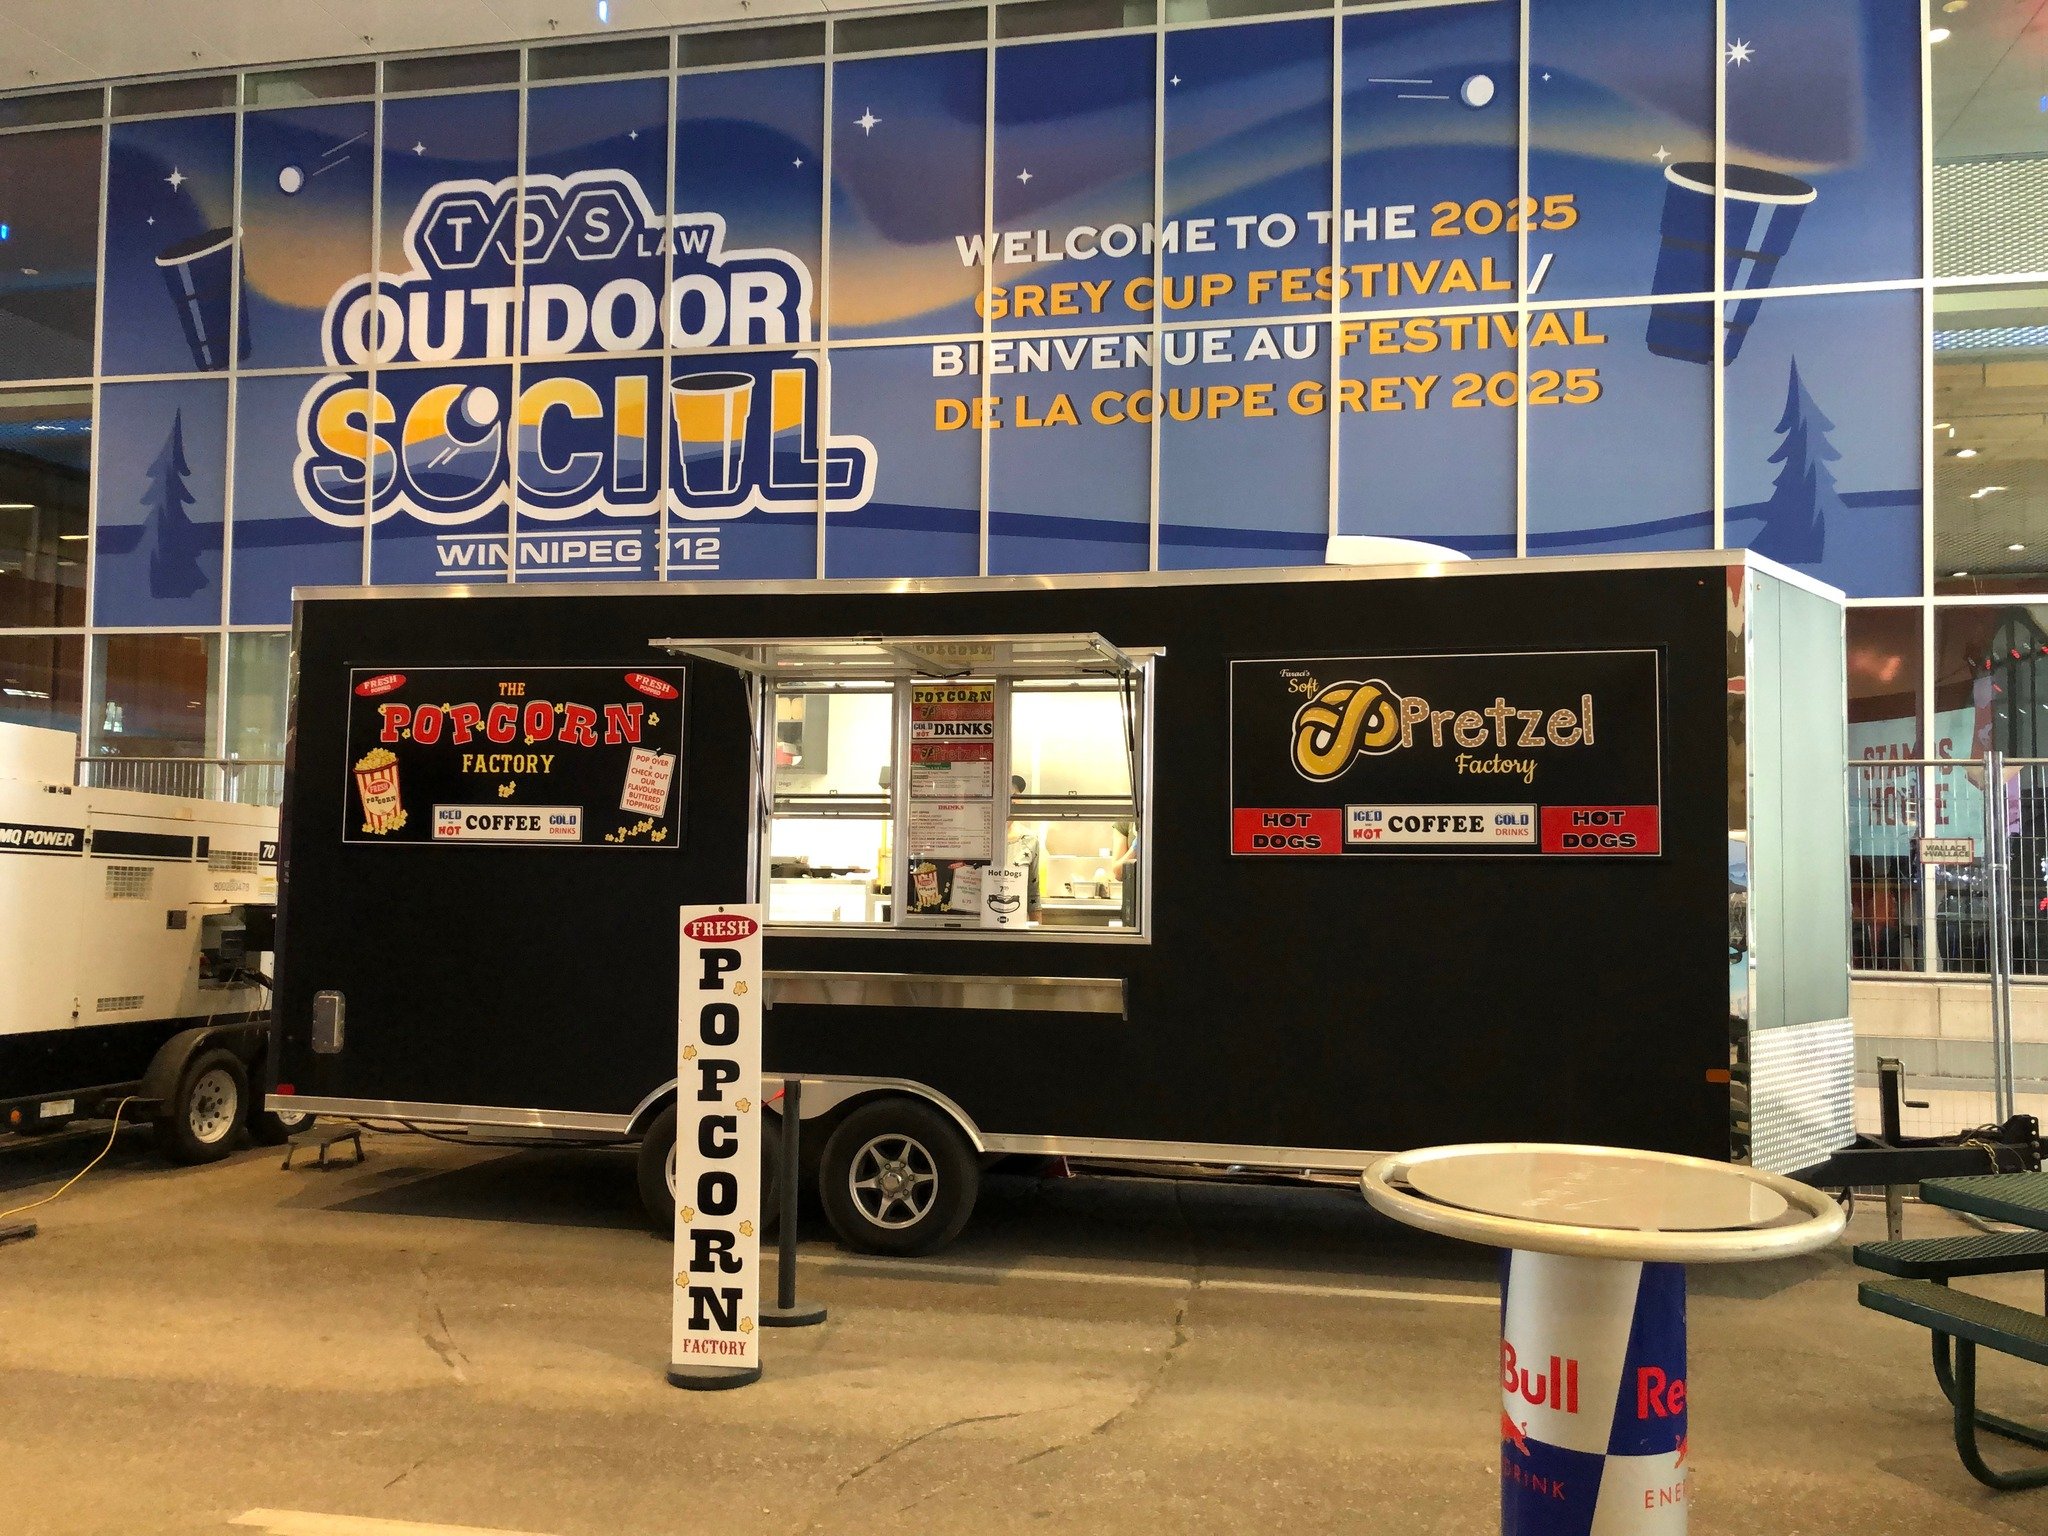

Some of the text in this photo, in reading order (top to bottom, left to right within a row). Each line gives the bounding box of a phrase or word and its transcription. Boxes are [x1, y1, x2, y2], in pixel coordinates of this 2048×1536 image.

[955, 193, 1578, 267] WELCOME TO THE 2025
[637, 229, 709, 258] LAW
[974, 280, 1112, 321] GREY
[1123, 272, 1233, 312] CUP
[1248, 256, 1512, 305] FESTIVAL
[341, 270, 790, 365] OUTDOOR
[932, 310, 1606, 377] BIENVENUE AU FESTIVAL
[935, 367, 1601, 431] DE LA COUPE GREY 2025
[436, 539, 642, 567] WINNIPEG
[363, 674, 397, 690] FRESH
[498, 682, 526, 696] THE
[634, 673, 671, 693] FRESH
[1287, 676, 1320, 700] Soft
[914, 690, 992, 703] POPCORN
[379, 700, 644, 748] POPCORN
[934, 723, 992, 736] DRINKS
[1400, 693, 1595, 749] Pretzel
[461, 754, 556, 774] FACTORY
[636, 754, 669, 767] POP OVER
[1454, 752, 1538, 784] Factory
[1863, 737, 1953, 781] STAMS
[631, 767, 669, 780] CHECK OUT
[640, 777, 656, 786] OUR
[627, 783, 666, 796] FLAVOURED
[628, 791, 661, 804] BUTTERED
[438, 809, 462, 820] ICED
[1867, 783, 1950, 826] HOUE
[465, 814, 577, 832] COFFEE COLD
[1262, 809, 1627, 833] HOT COFFEE COLD HOT
[1353, 809, 1383, 822] ICED
[438, 825, 576, 836] HOT DRINKS
[1252, 831, 1638, 850] DOGS DOGS
[1352, 827, 1530, 840] HOT DRINKS
[0, 828, 276, 859] MQ POWER 70
[988, 869, 1022, 878] Hot Dogs
[691, 919, 751, 938] FRESH
[687, 947, 743, 1332] POPCORN
[682, 1338, 747, 1356] FACTORY
[1502, 1338, 1578, 1414] Bull
[1637, 1366, 1687, 1420] Re
[1644, 1478, 1687, 1509] ENE
